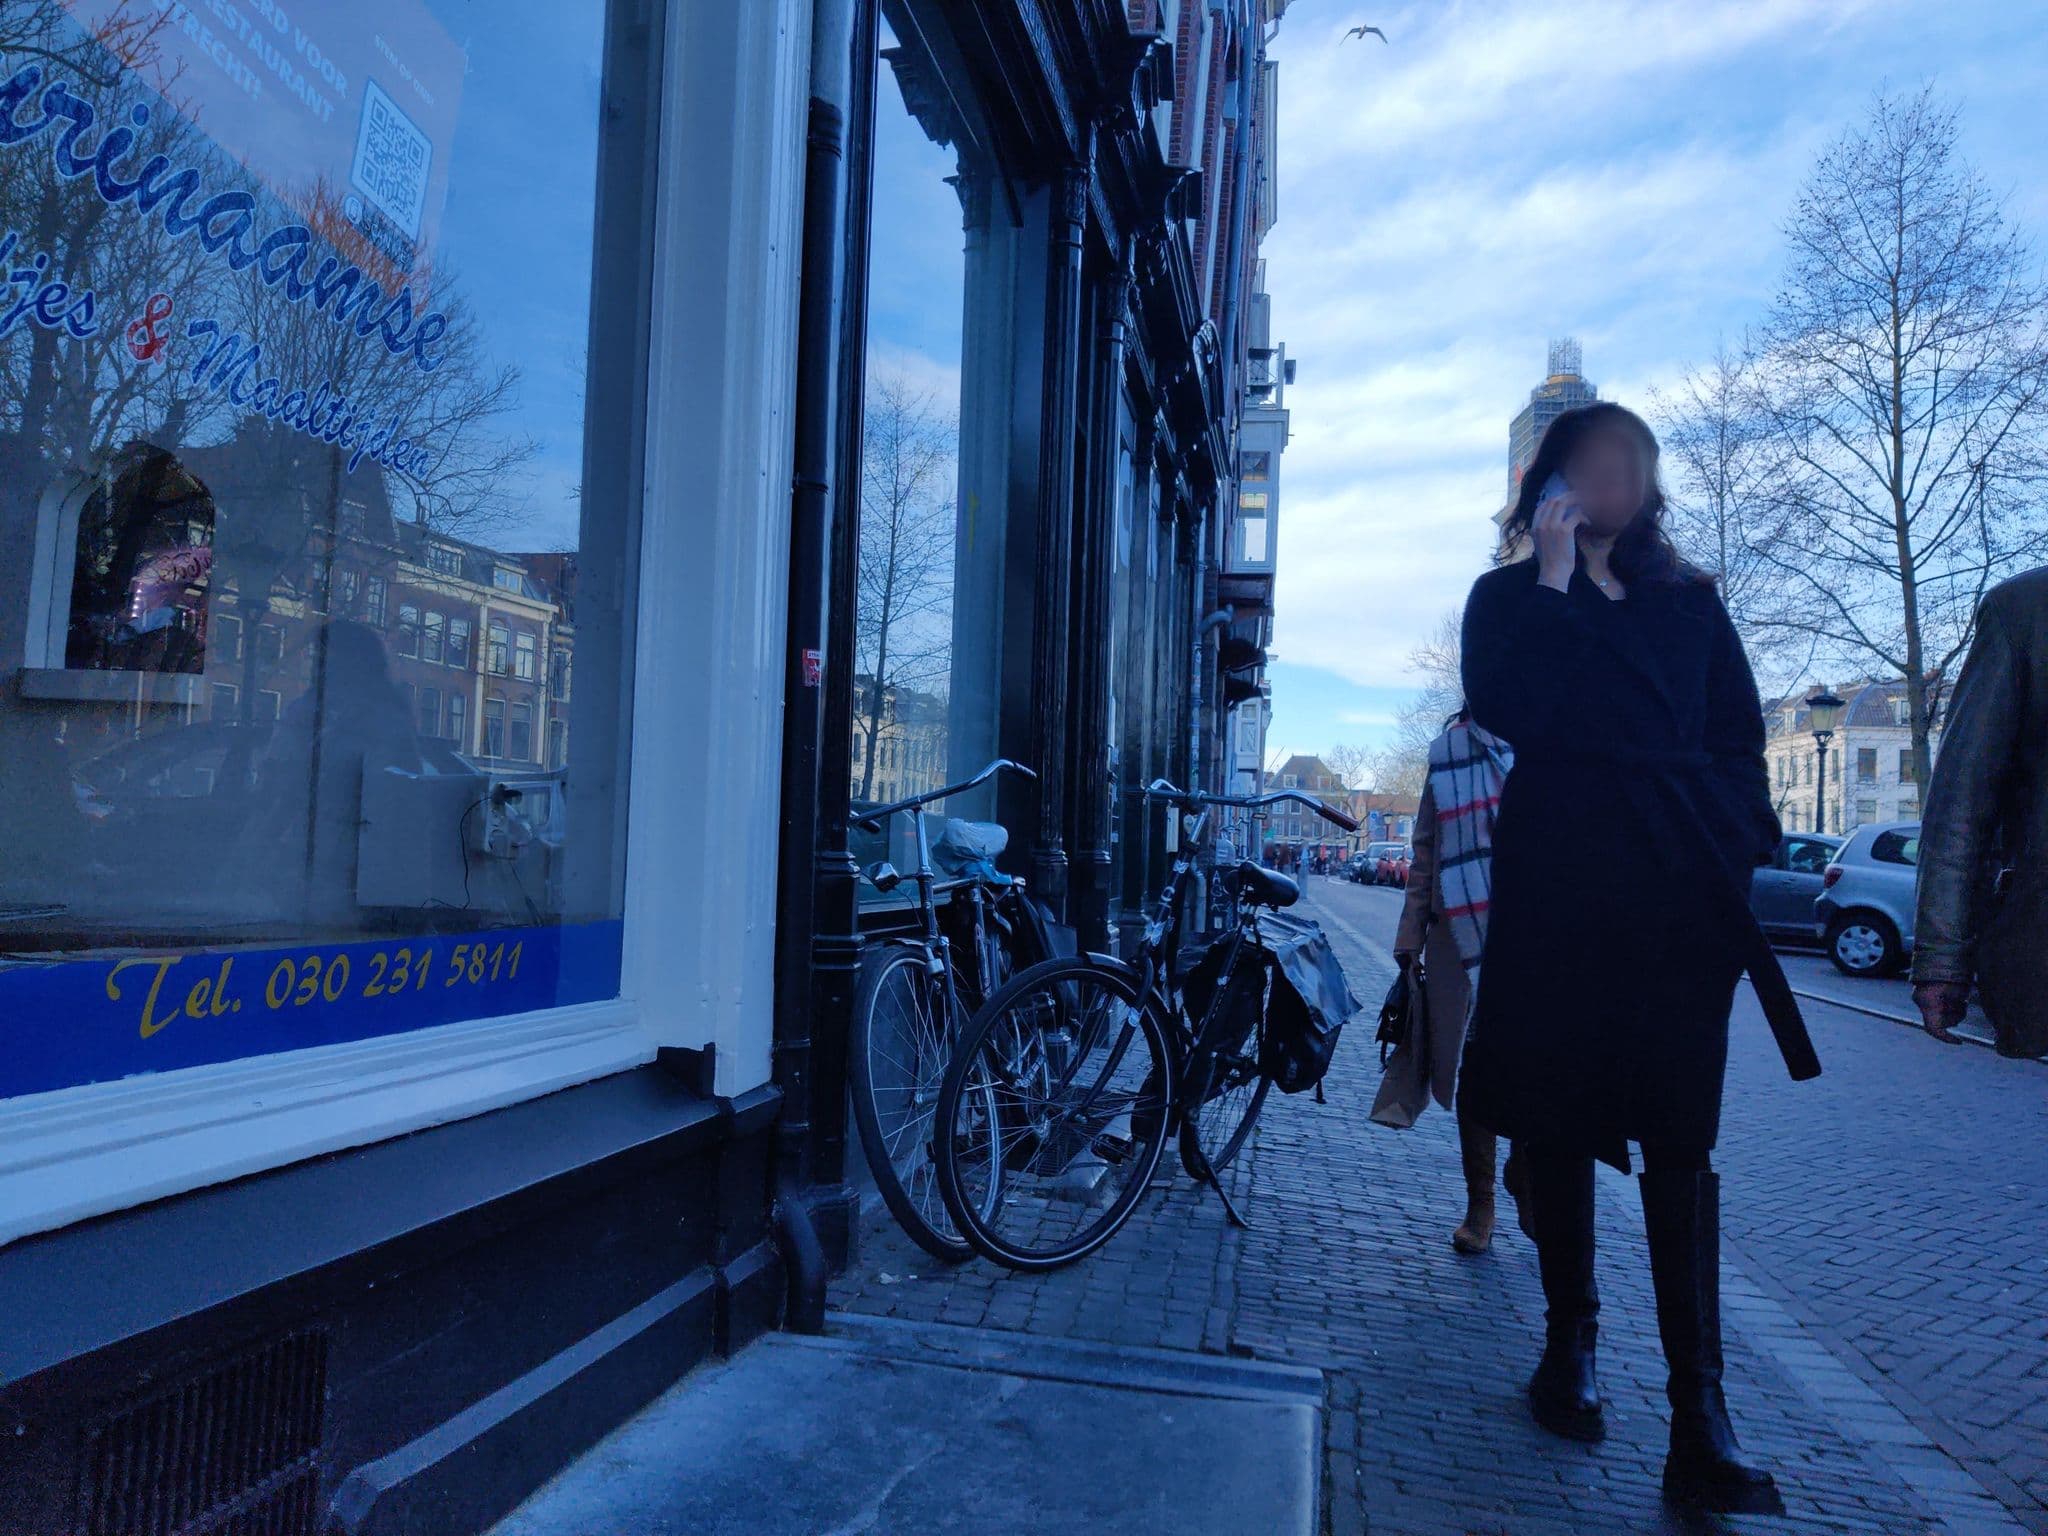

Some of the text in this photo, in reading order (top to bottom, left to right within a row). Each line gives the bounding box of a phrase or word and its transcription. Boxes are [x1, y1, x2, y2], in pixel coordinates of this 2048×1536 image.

[295, 26, 348, 100] VOOR
[125, 292, 174, 366] &
[188, 319, 431, 474] Maaltijden
[105, 940, 524, 1040] Tel. 030 231 5811
